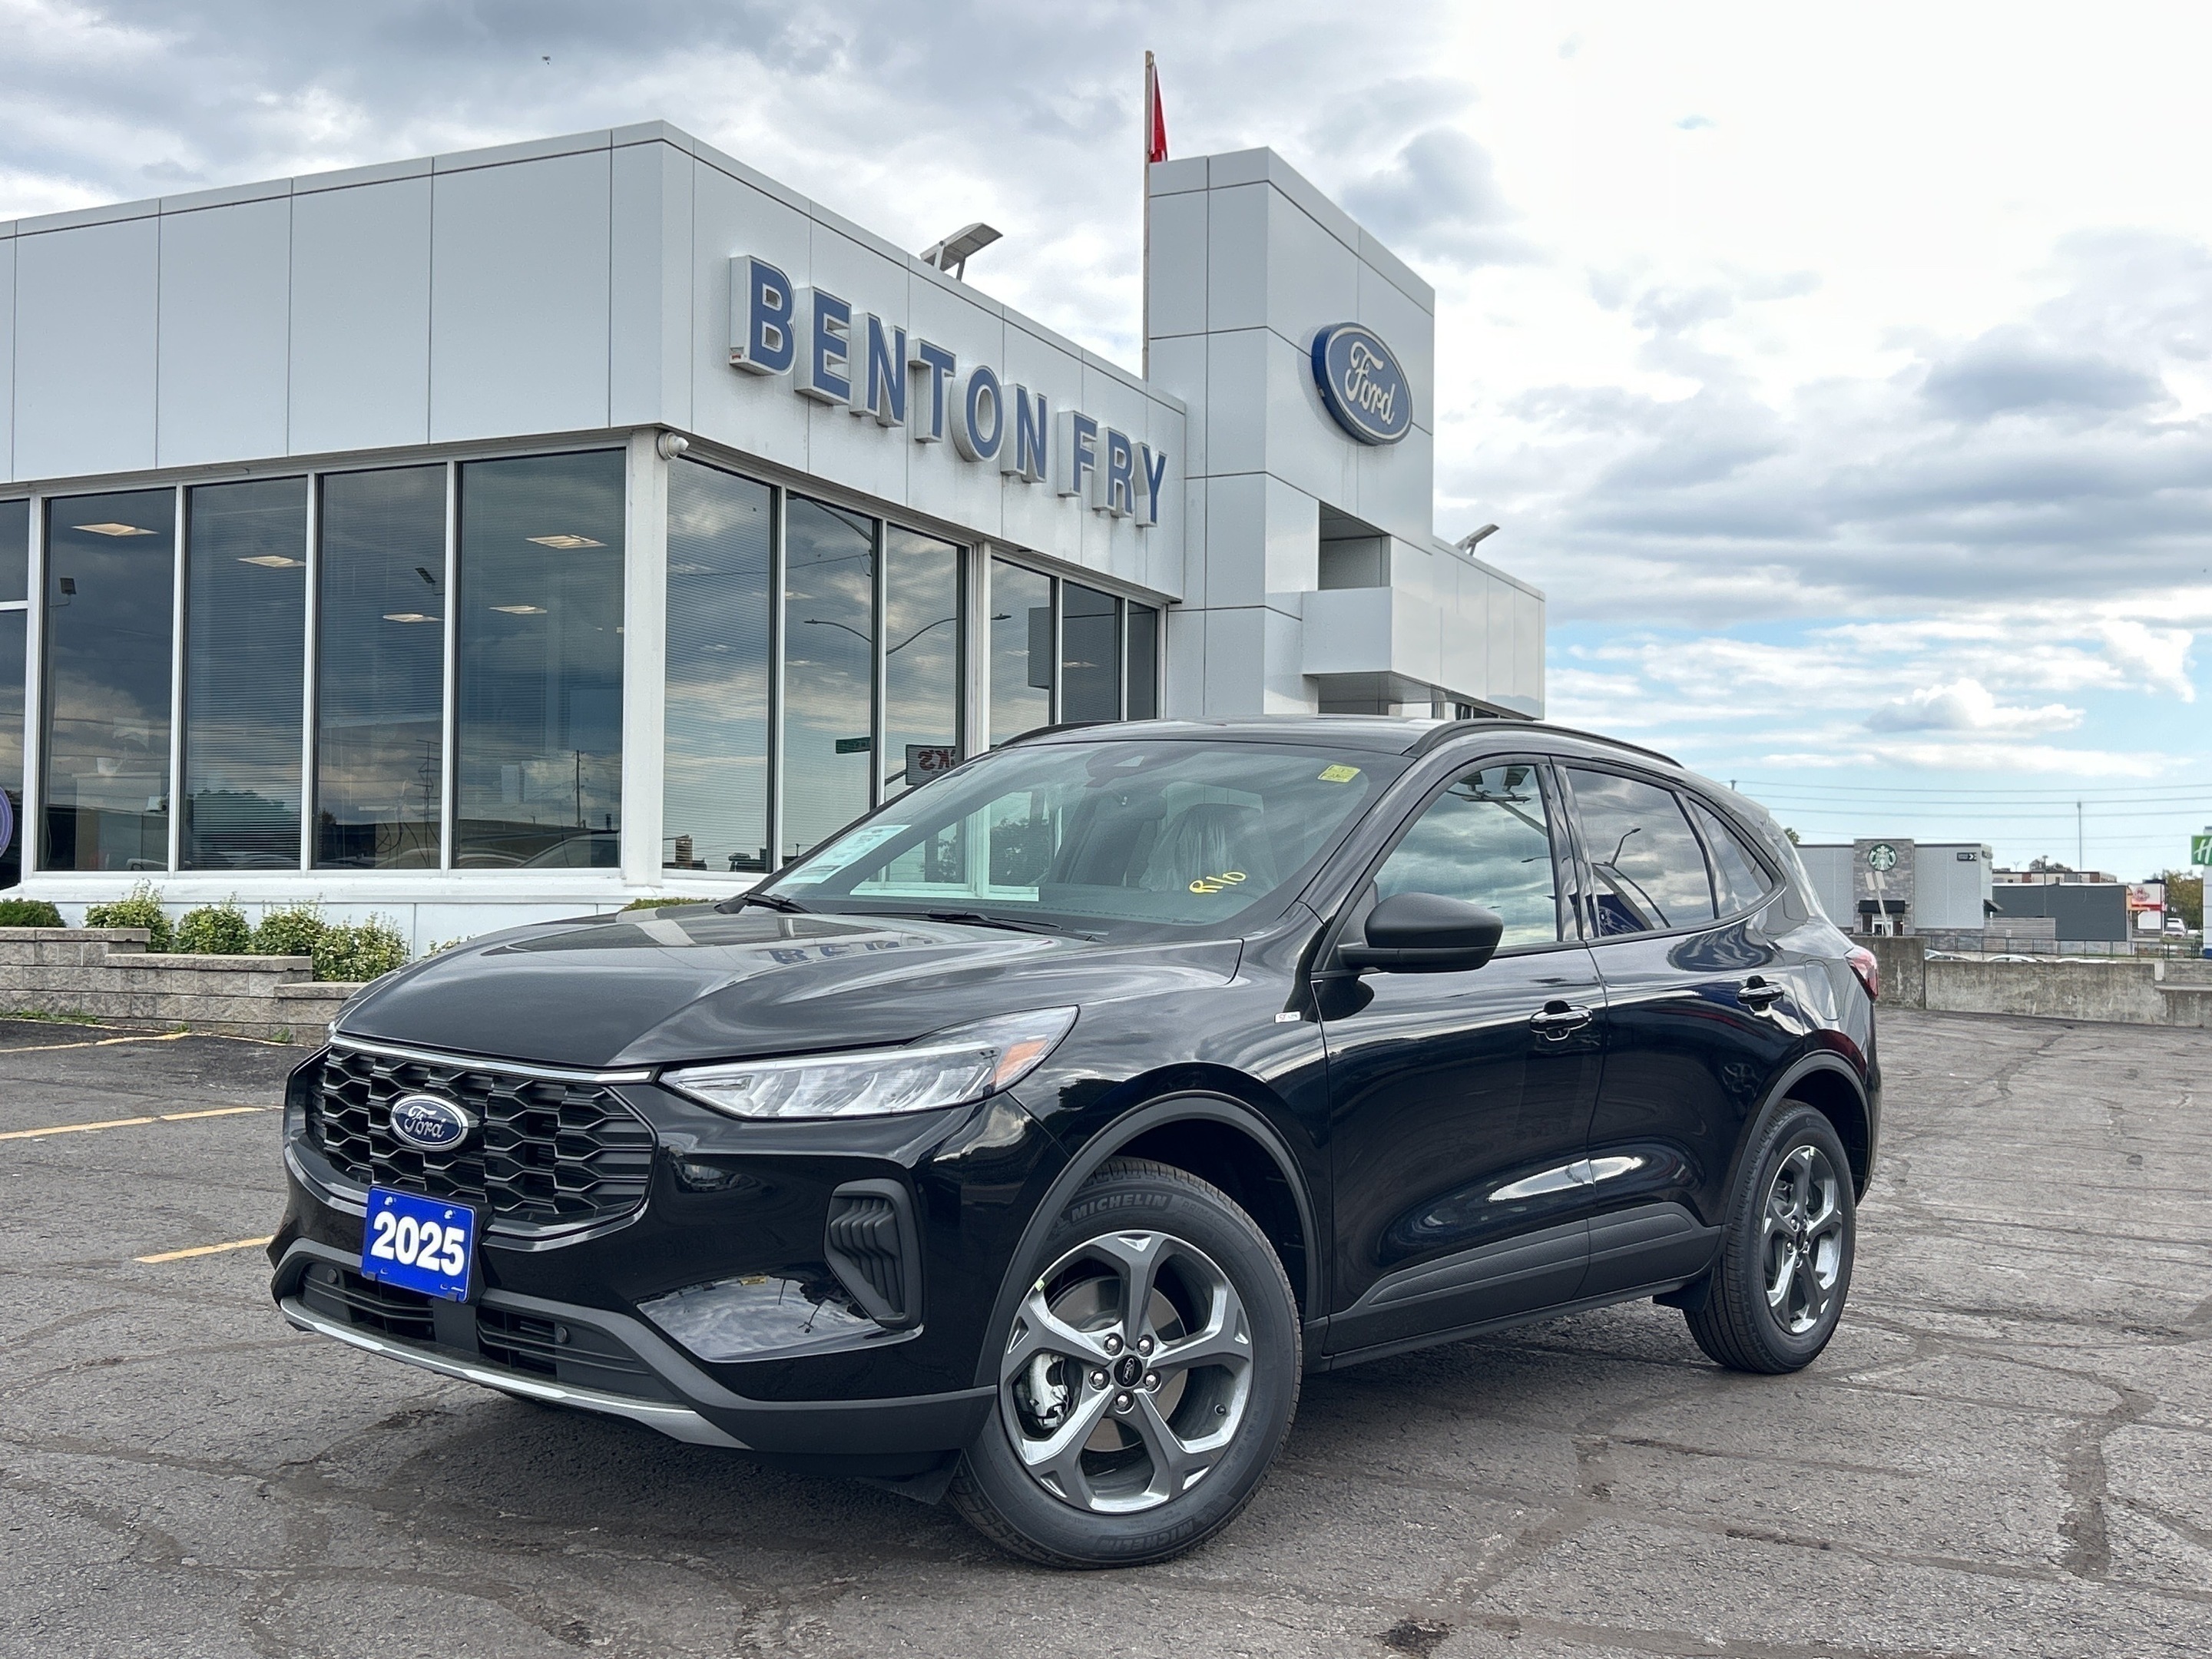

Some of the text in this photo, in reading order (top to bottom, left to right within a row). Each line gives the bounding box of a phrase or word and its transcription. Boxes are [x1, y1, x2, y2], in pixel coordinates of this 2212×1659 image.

[747, 255, 1167, 527] BENTON FRY
[1345, 341, 1396, 425] Ford
[404, 1106, 446, 1138] Ford
[1071, 1193, 1168, 1222] MICHELIN
[370, 1210, 465, 1277] 2025
